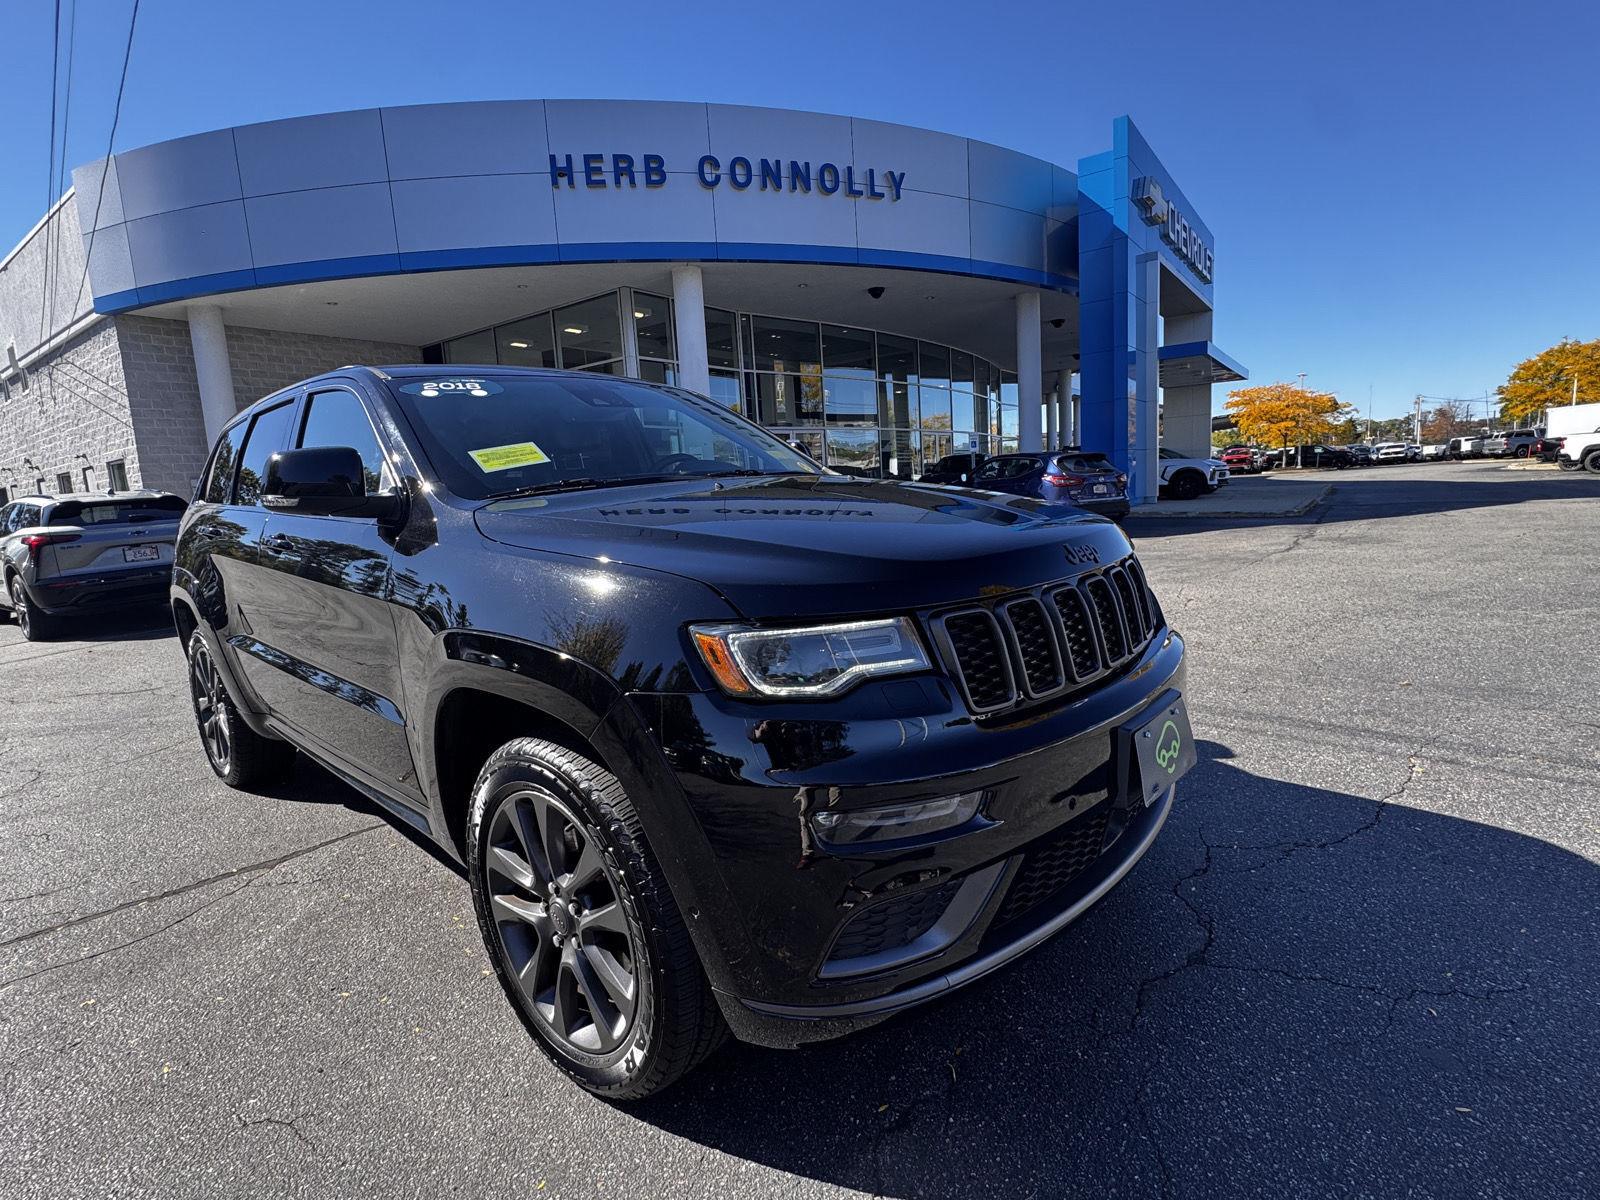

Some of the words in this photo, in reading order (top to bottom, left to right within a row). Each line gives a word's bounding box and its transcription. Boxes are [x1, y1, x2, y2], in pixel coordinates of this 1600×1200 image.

[549, 153, 667, 188] HERB
[697, 155, 905, 200] CONNOLLY
[423, 382, 481, 390] 2018
[1063, 543, 1099, 565] Jeep
